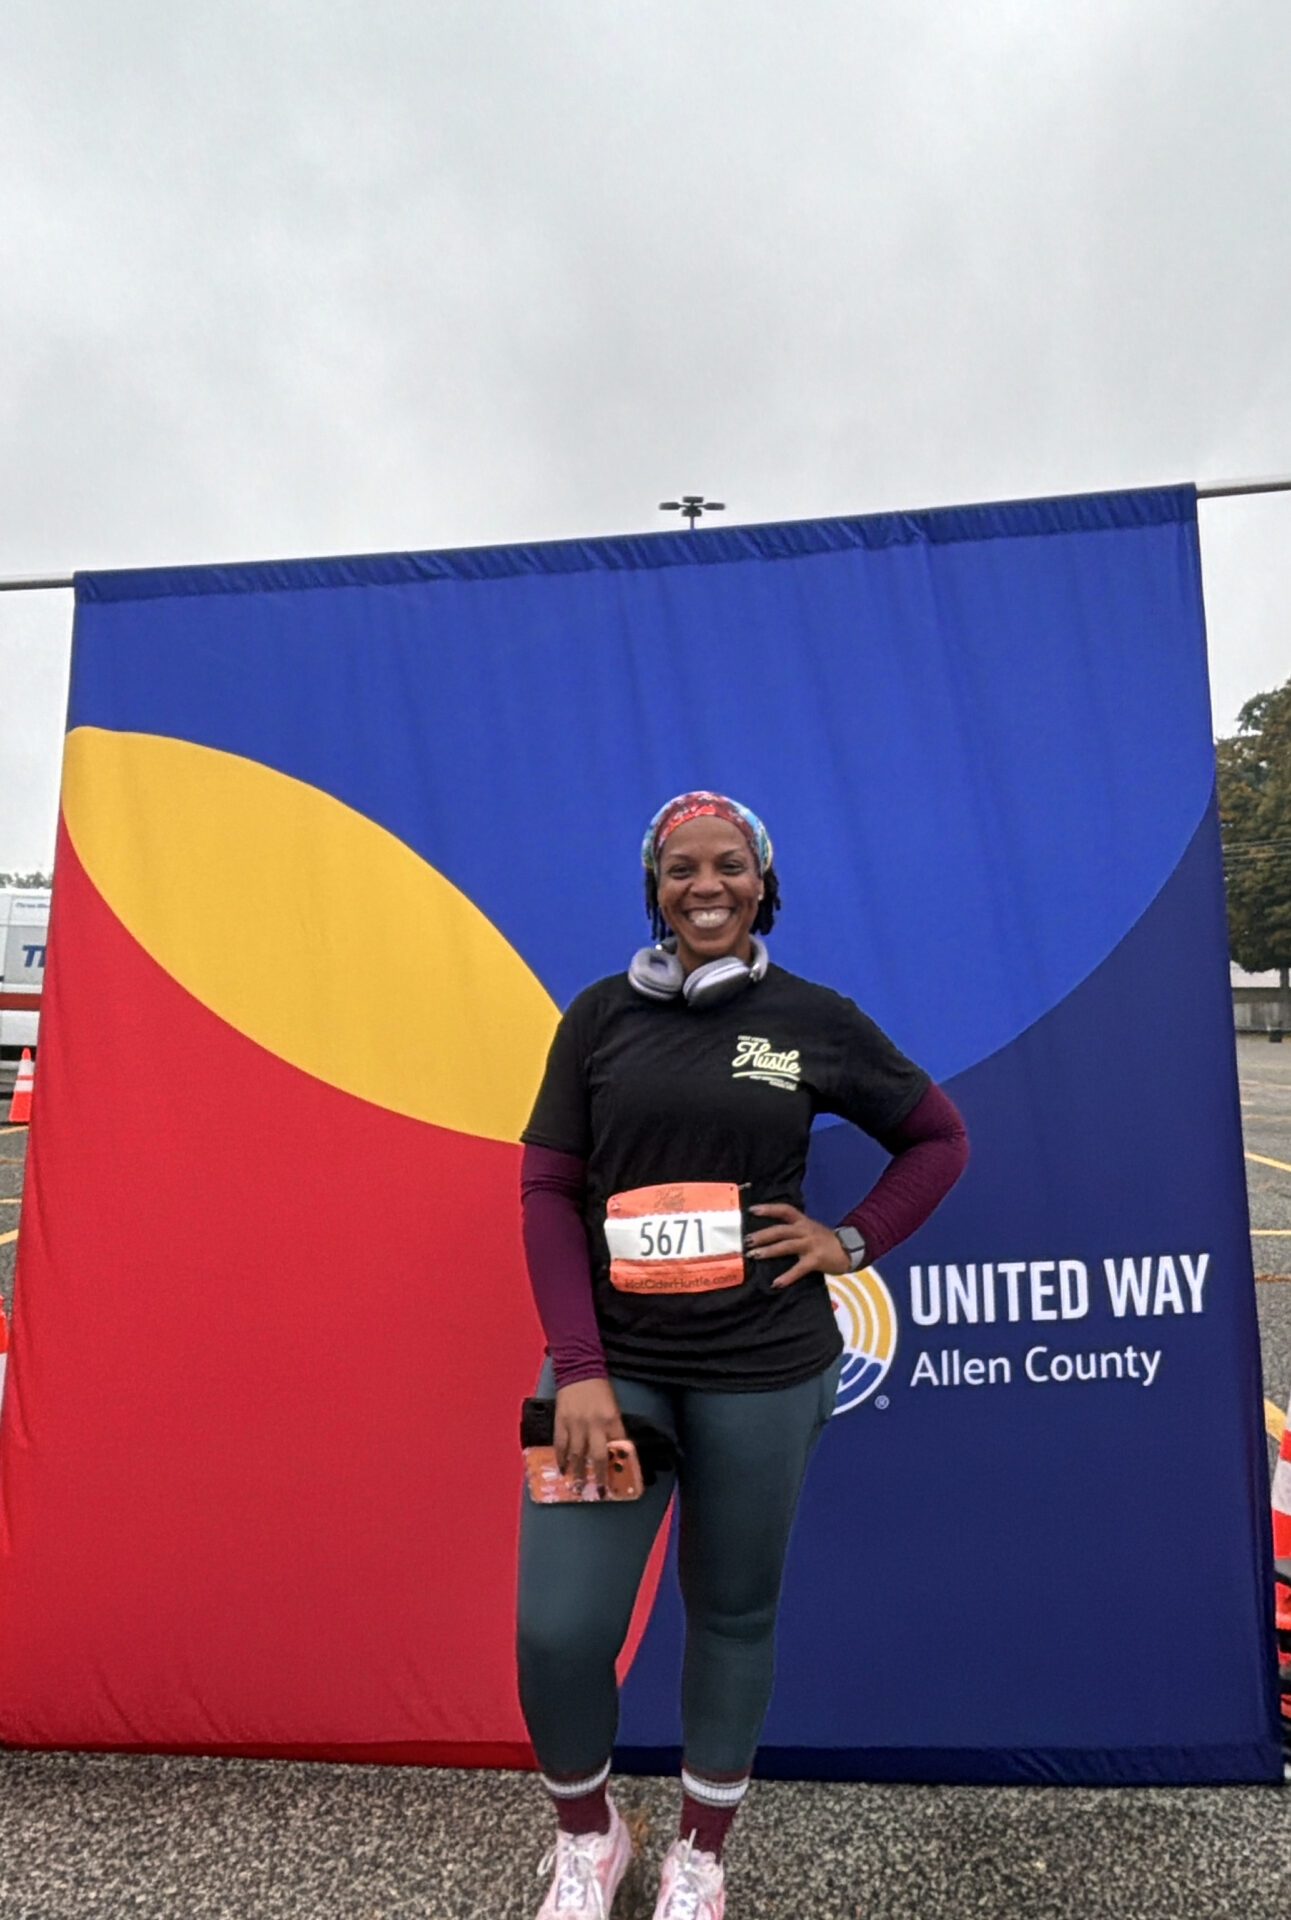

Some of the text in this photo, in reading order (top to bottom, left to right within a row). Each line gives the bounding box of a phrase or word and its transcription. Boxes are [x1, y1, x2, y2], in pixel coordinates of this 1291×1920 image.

[731, 1041, 802, 1075] Hustle
[640, 1218, 705, 1257] 5671
[910, 1253, 1210, 1326] UNITED WAY
[910, 1345, 1161, 1387] Allen County
